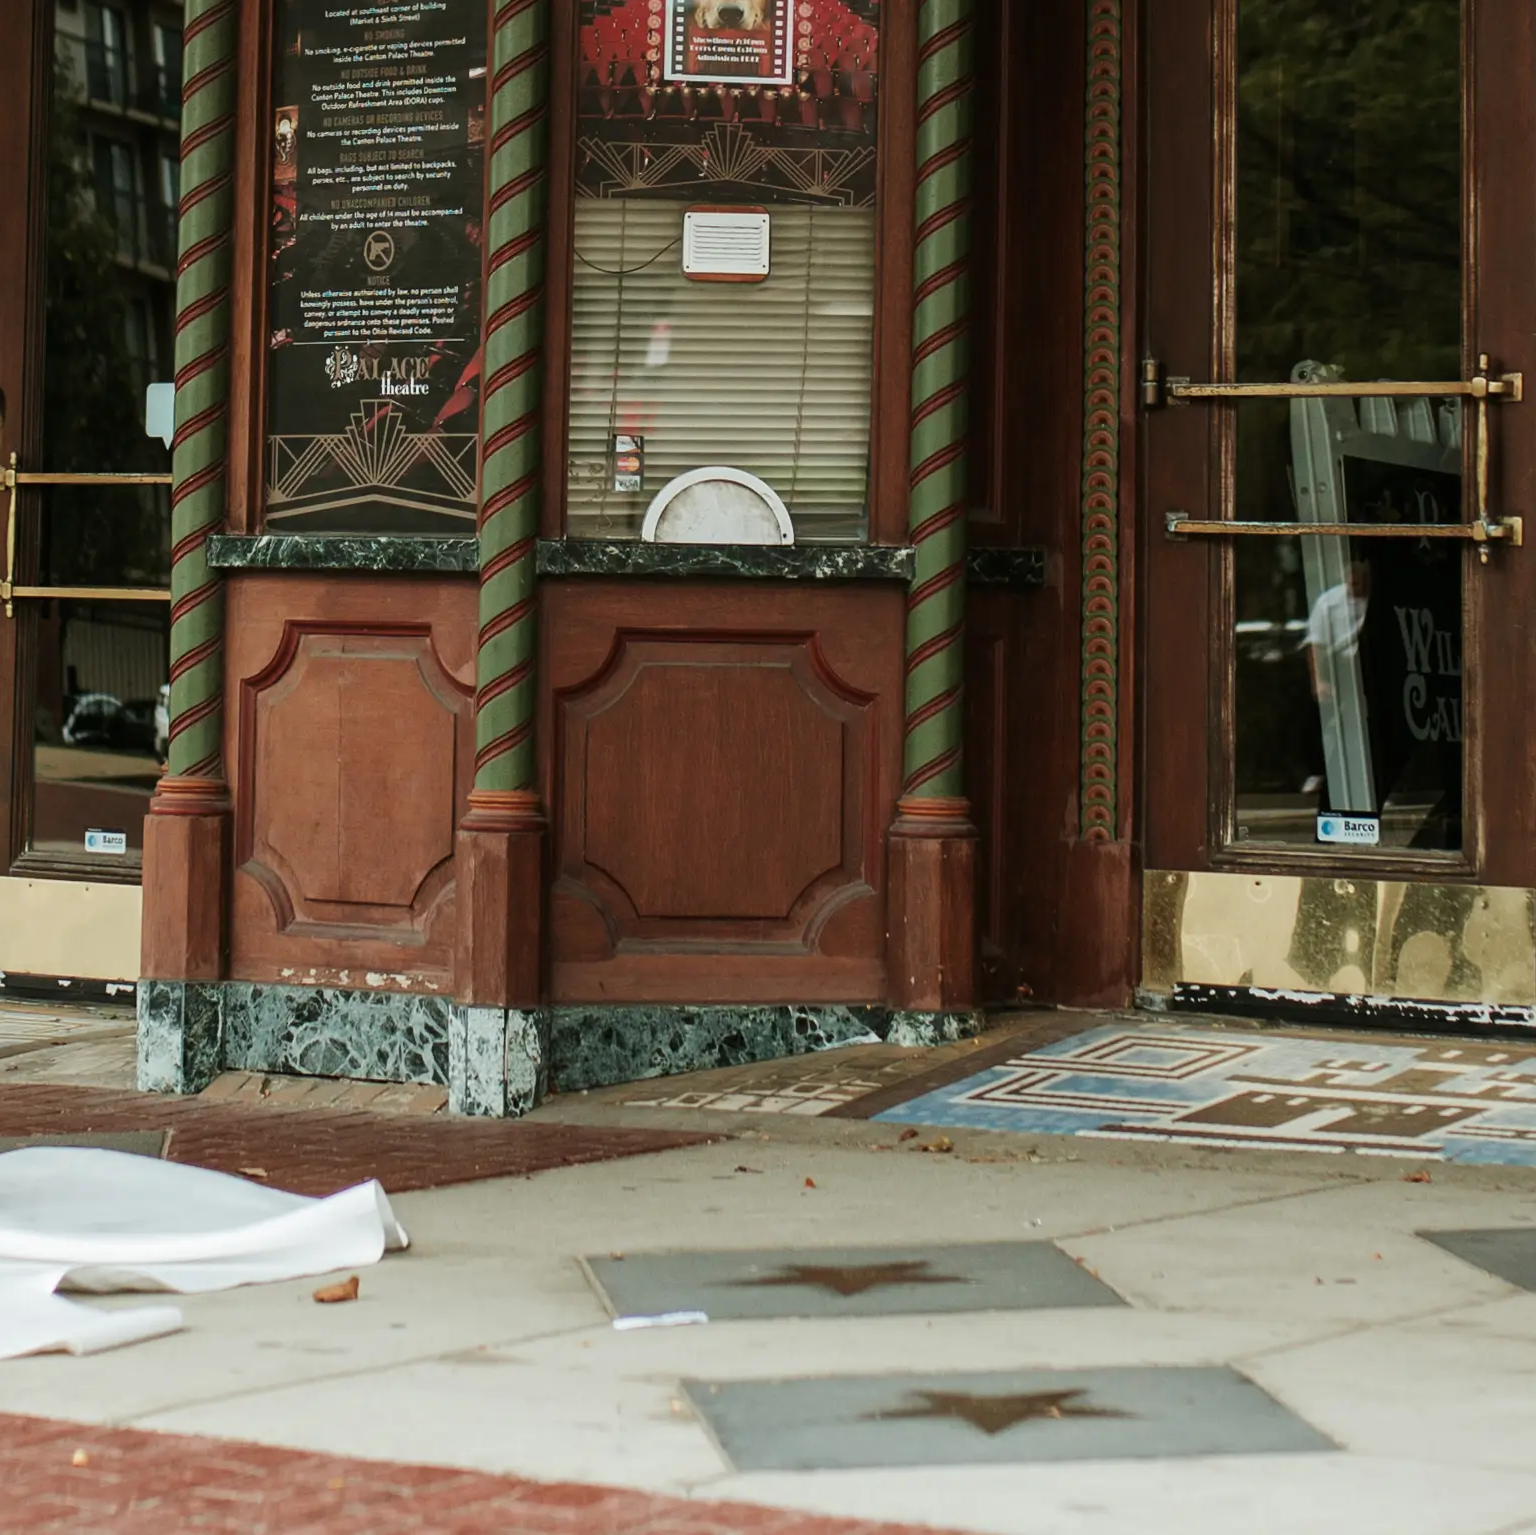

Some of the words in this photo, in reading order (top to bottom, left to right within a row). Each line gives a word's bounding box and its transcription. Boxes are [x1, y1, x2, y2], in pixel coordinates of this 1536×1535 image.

[326, 347, 431, 381] PALACE
[380, 371, 429, 395] theatre
[1395, 604, 1462, 677] WIL
[1403, 673, 1462, 741] CAL
[1344, 821, 1375, 832] Barco
